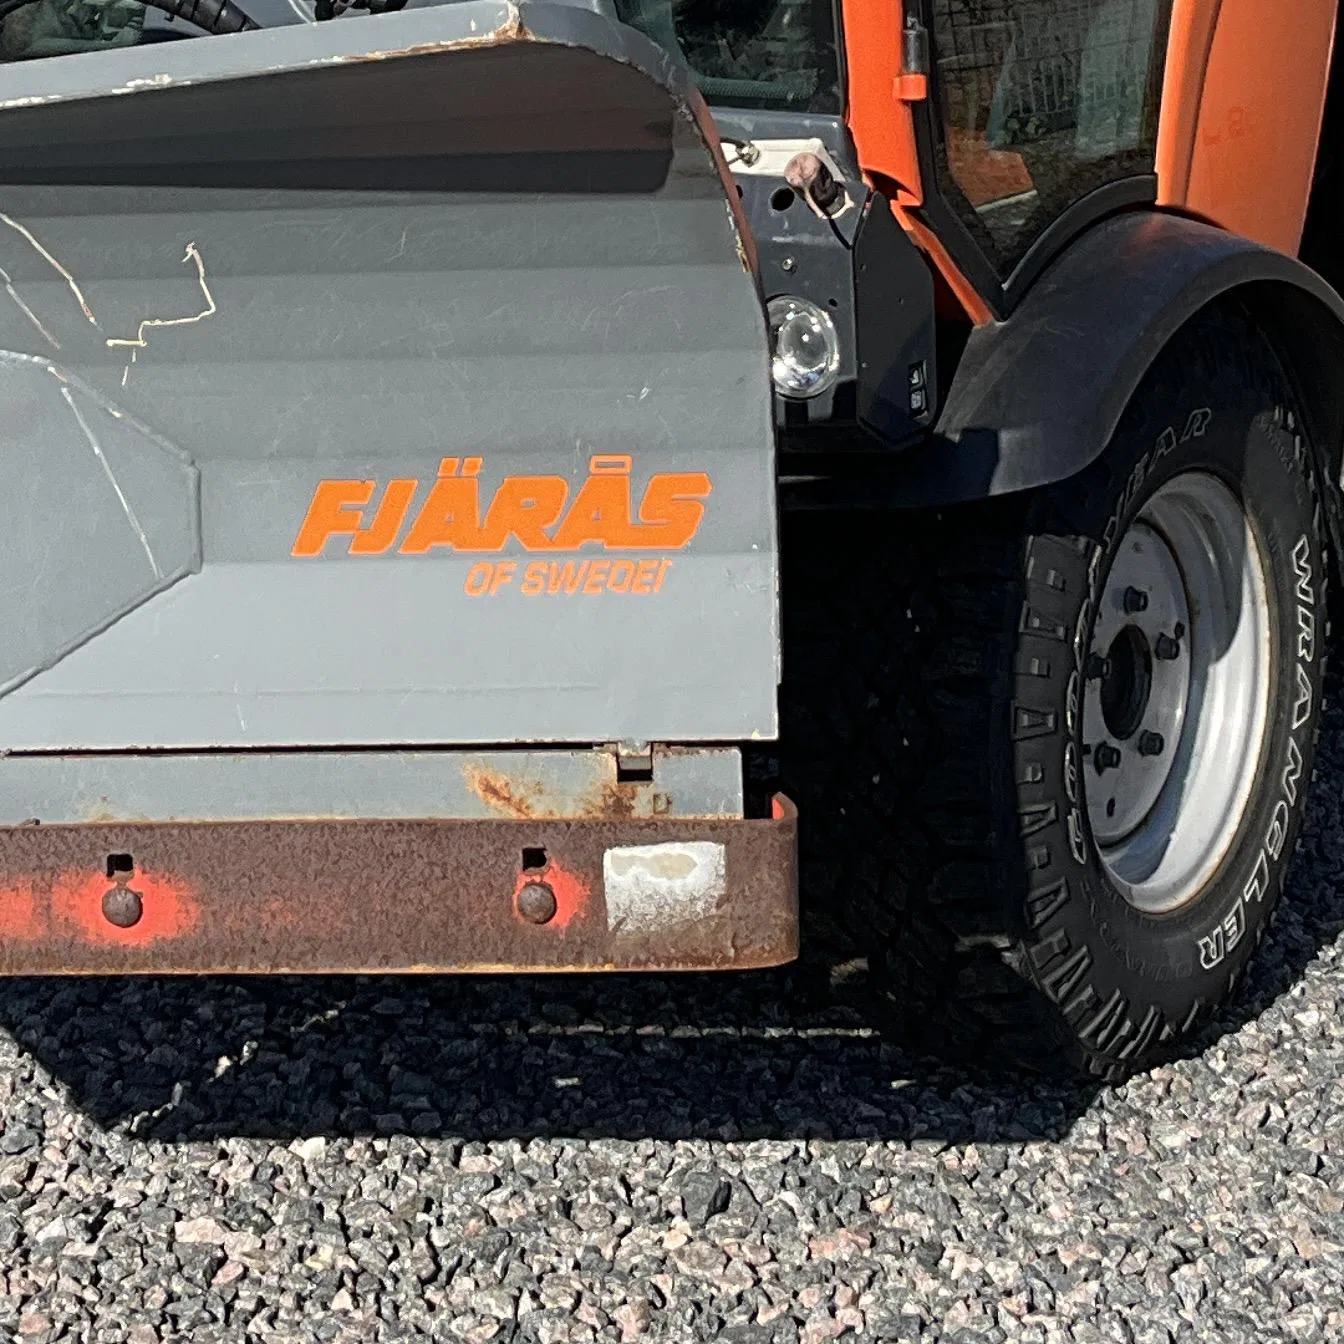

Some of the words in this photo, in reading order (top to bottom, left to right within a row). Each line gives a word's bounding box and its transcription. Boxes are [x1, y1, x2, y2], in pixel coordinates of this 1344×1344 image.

[290, 452, 713, 557] FJÄRÅS
[463, 560, 518, 598] OF
[1196, 532, 1314, 971] WRANGLER
